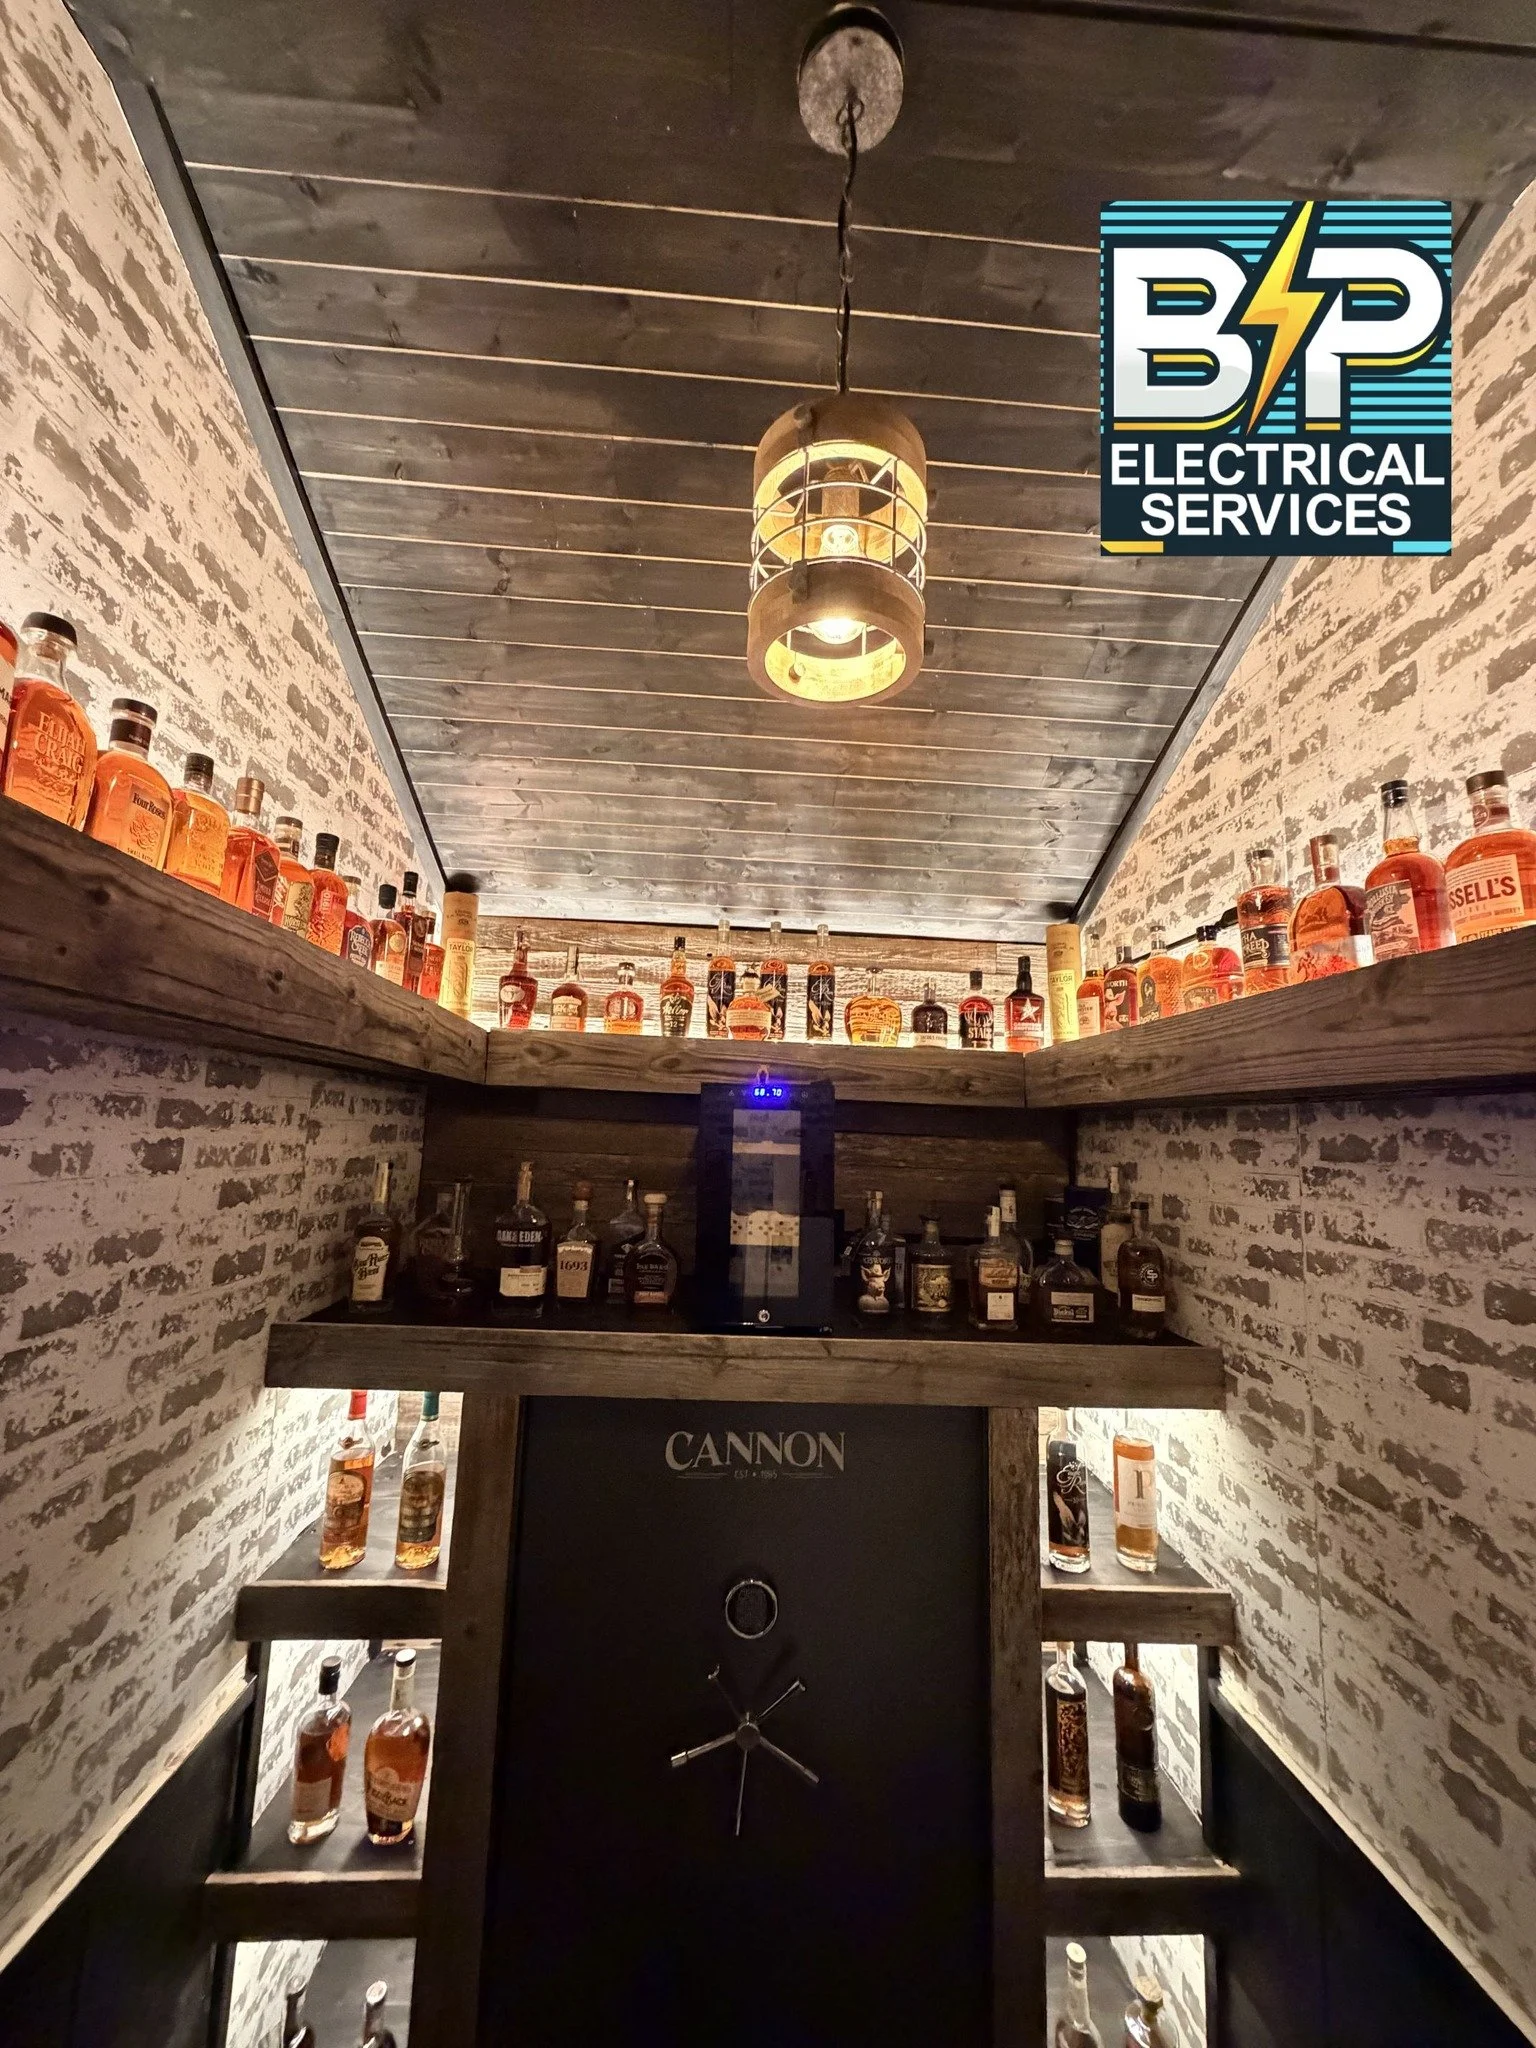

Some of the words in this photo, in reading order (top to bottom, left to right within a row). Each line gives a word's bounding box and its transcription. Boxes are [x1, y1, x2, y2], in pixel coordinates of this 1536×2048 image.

[35, 733, 85, 774] CRAIG
[39, 711, 87, 757] ELIJAH
[664, 1431, 846, 1472] CANNON
